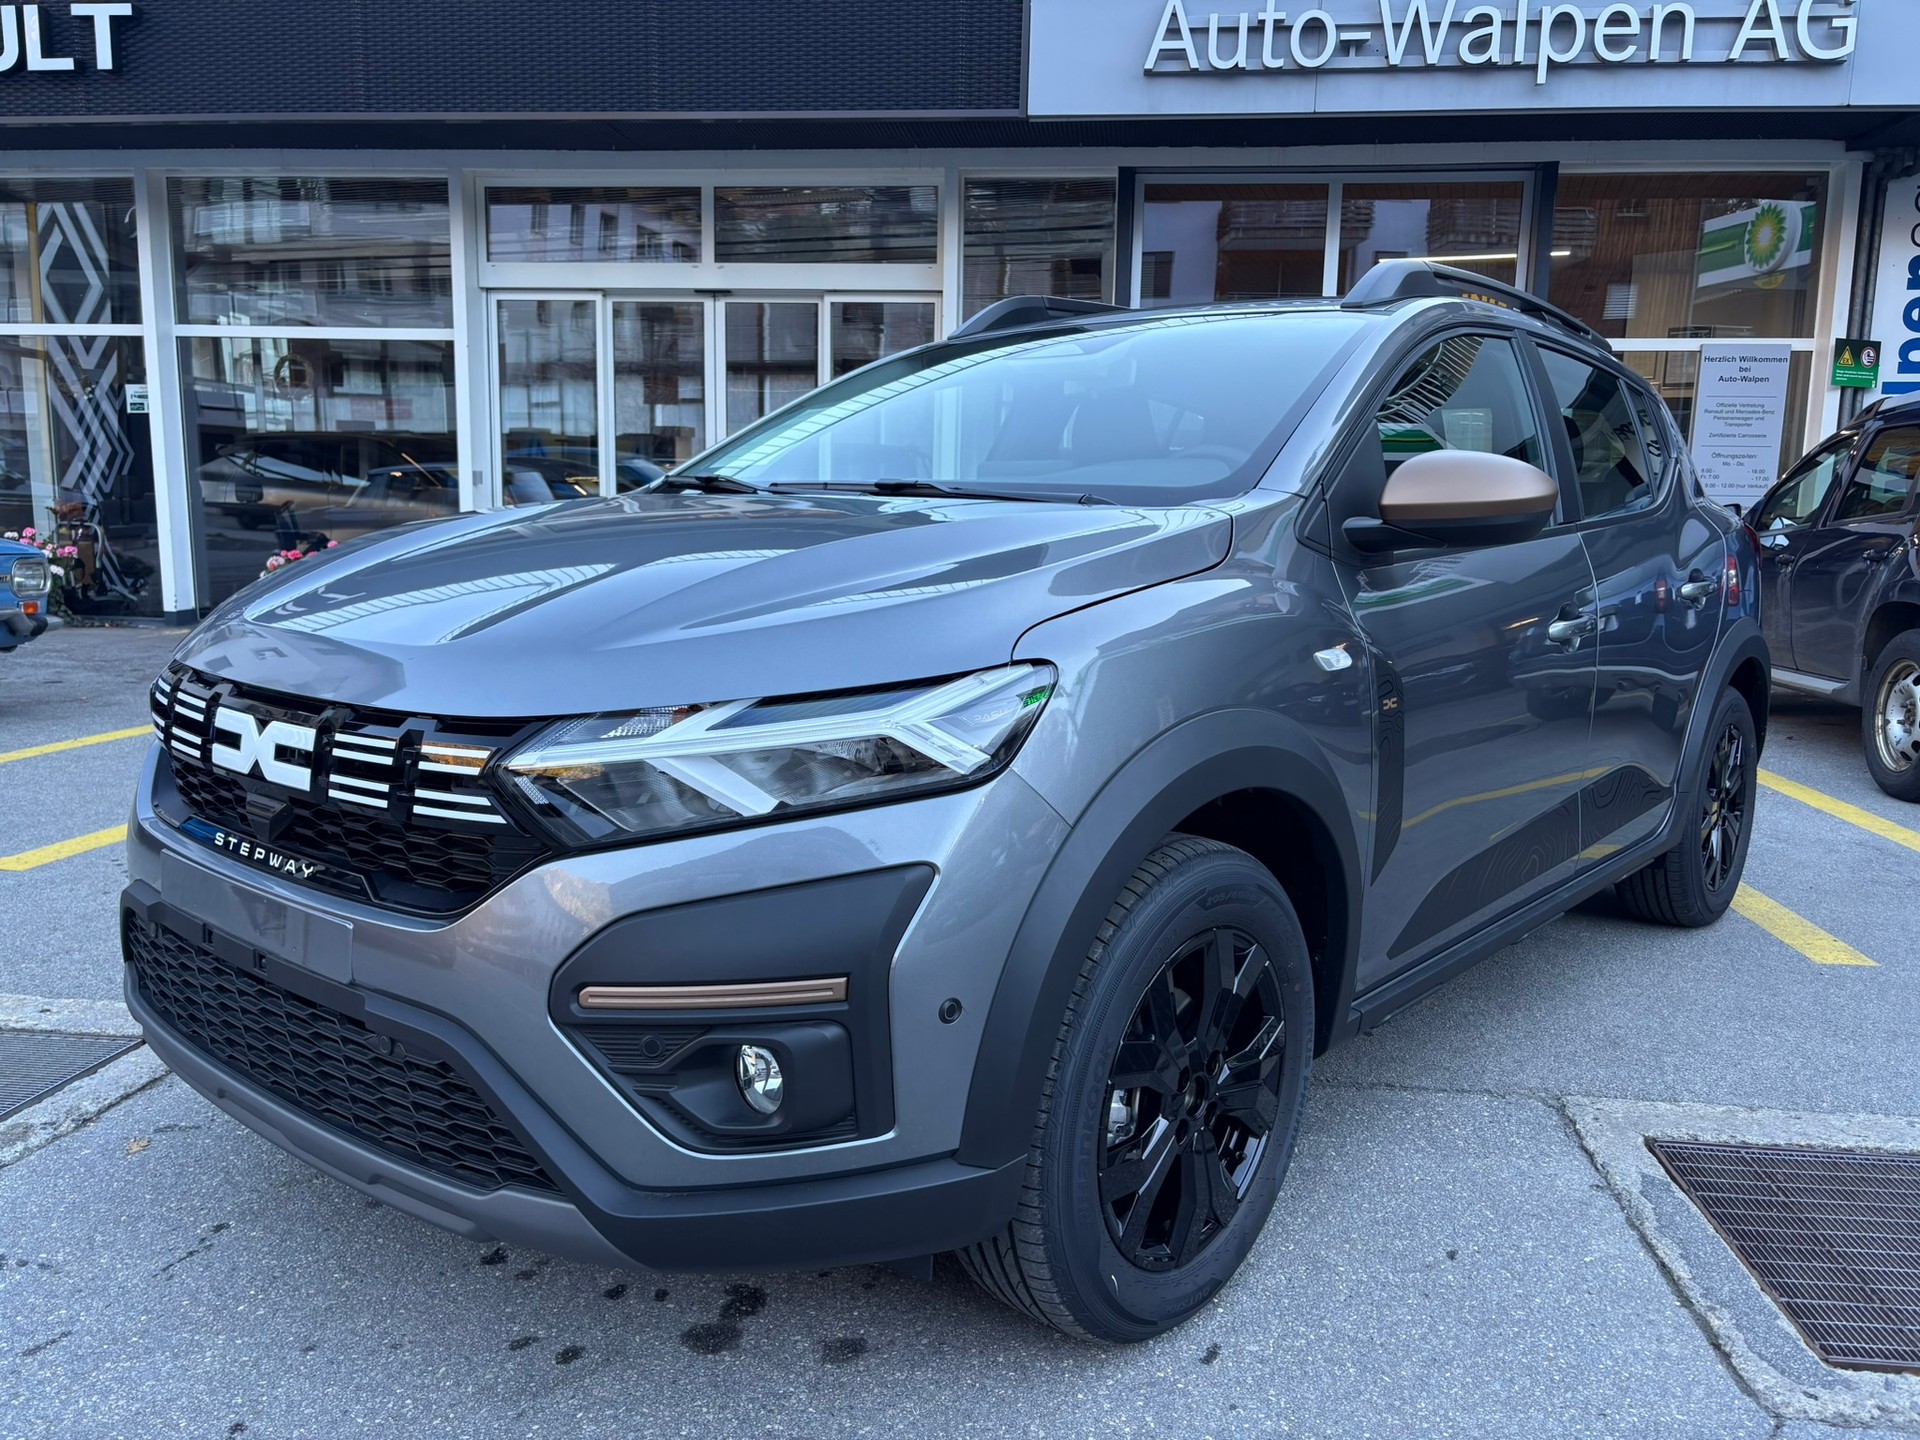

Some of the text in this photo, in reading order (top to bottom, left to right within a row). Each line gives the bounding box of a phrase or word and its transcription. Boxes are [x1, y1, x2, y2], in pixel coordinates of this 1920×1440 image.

[1144, 0, 1858, 85] Auto-Walpen AG
[1704, 355, 1788, 363] Herzlich Willkommen
[1739, 365, 1751, 373] bei
[1718, 375, 1770, 384] Auto-Walpen
[214, 832, 314, 878] STEPWAY
